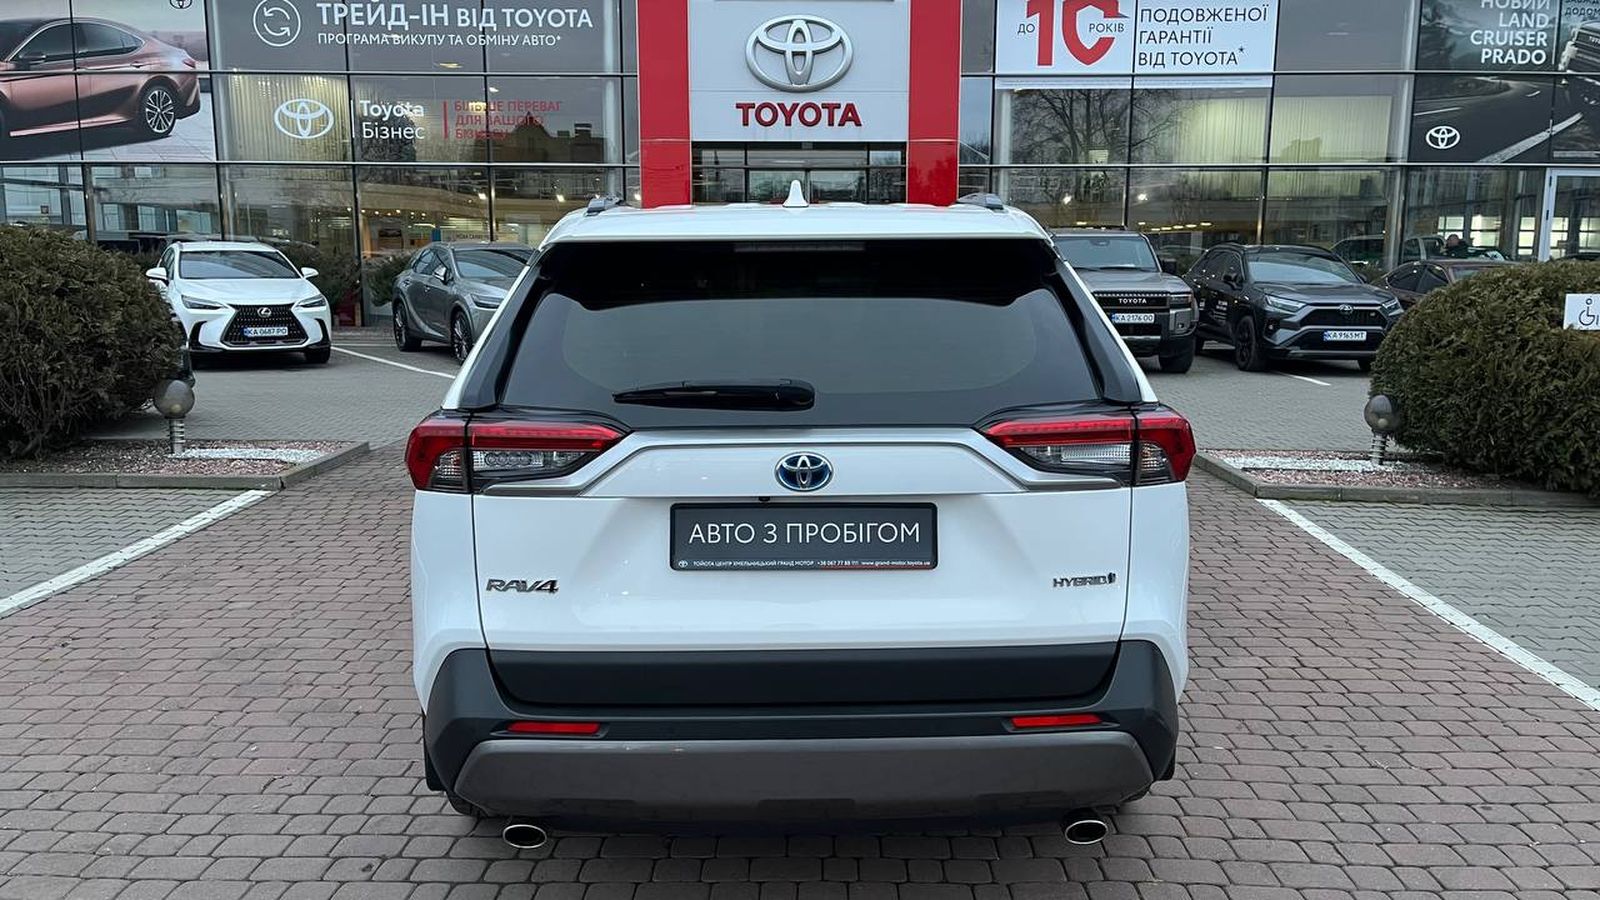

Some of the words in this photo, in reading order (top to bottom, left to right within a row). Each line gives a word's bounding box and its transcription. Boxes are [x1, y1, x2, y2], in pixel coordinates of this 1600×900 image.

[316, 0, 449, 30] ТРЕЙД-ІН
[457, 8, 497, 31] ВІД
[502, 8, 593, 28] TOYOTA
[1140, 4, 1270, 25] ПОДОВЖЕНОЇ
[1500, 13, 1549, 28] LAND
[1017, 23, 1035, 34] ДО
[1088, 23, 1125, 33] РОКІВ
[1139, 26, 1213, 44] ГАРАНТІЇ
[318, 33, 390, 46] ПРОГРАМА
[392, 34, 445, 46] ВИКУПУ
[449, 34, 463, 46] ТА
[466, 34, 520, 46] ОБМІНУ
[1470, 30, 1548, 46] CRUISER
[1138, 52, 1165, 68] ВІД
[1481, 49, 1547, 64] PRADO
[359, 100, 425, 121] Toyota
[736, 102, 862, 127] TOYOTA
[456, 115, 481, 126] ДЛЯ
[362, 122, 425, 139] Бізнес
[688, 523, 755, 543] АВТО
[763, 523, 778, 543] З
[786, 523, 920, 543] ПРОБІГОМ
[486, 579, 559, 593] RAV4
[1053, 575, 1107, 587] HYBRID
